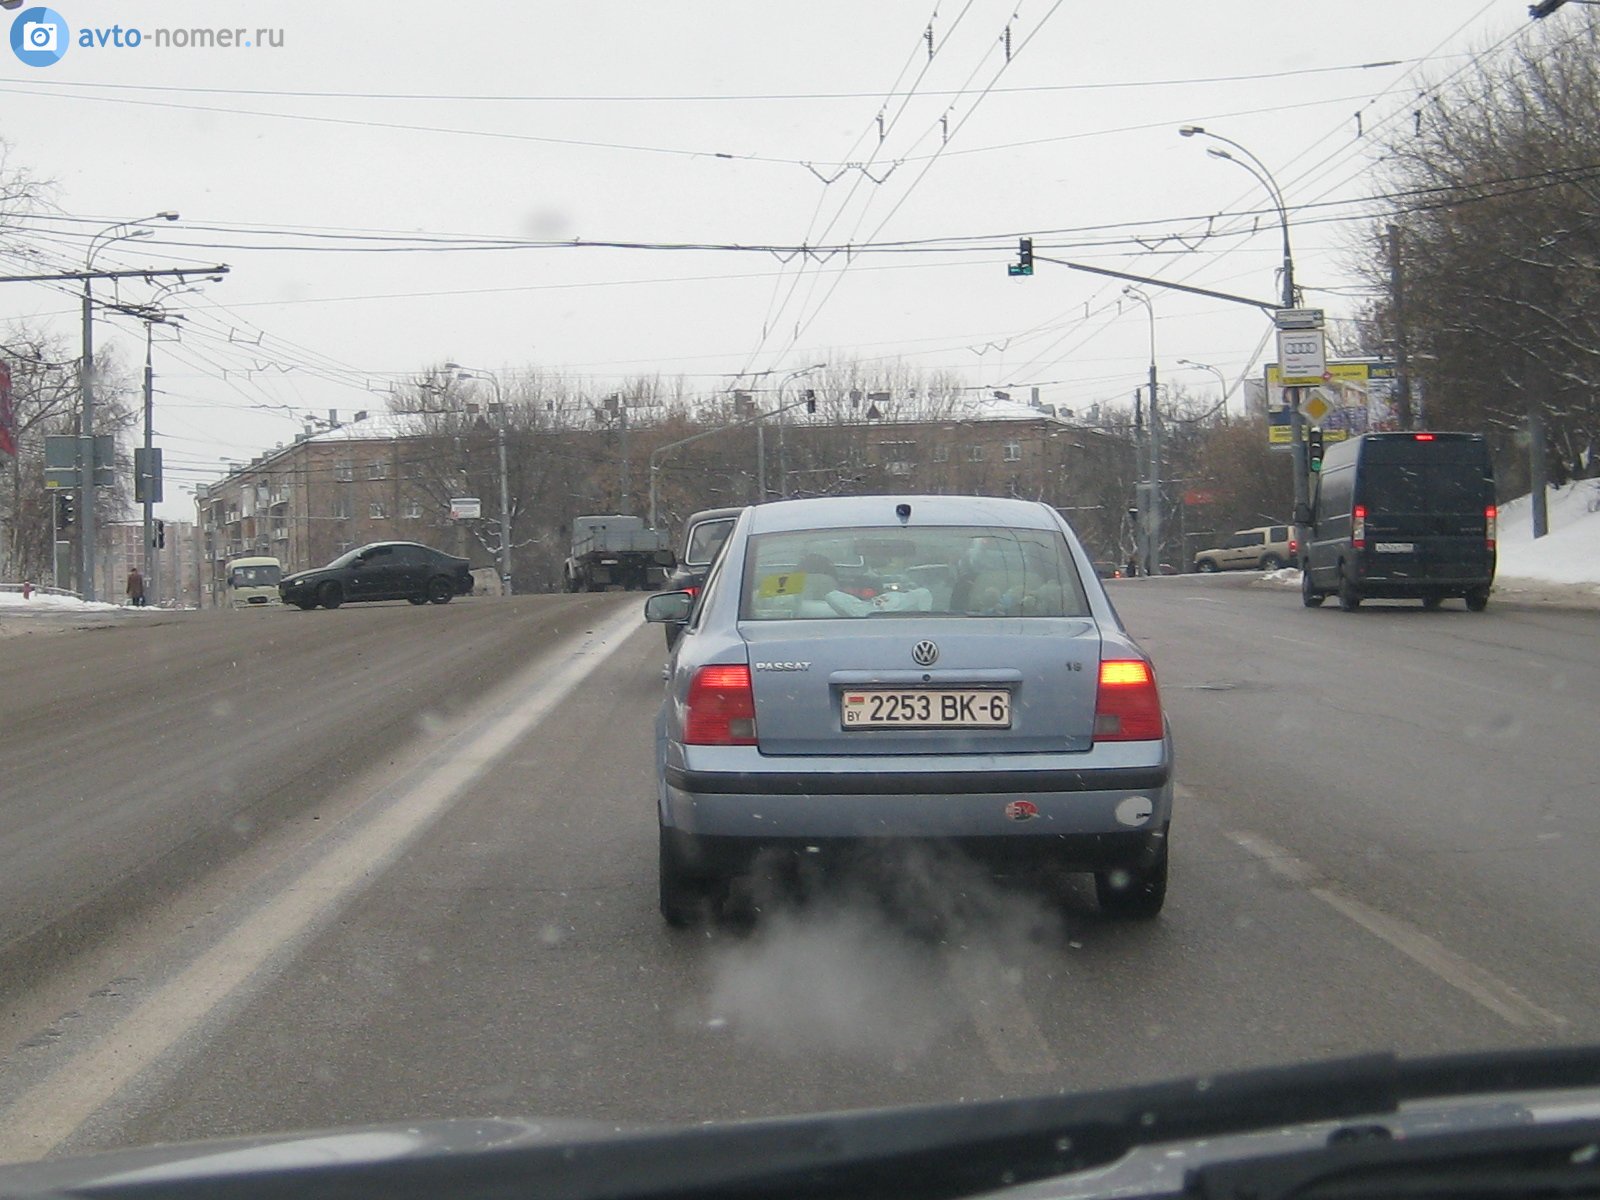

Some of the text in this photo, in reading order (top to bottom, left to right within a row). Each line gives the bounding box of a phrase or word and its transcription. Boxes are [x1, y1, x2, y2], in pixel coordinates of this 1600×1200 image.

[755, 661, 812, 672] PASSAT
[870, 695, 1004, 721] 2253 BK-6
[847, 711, 861, 721] BY
